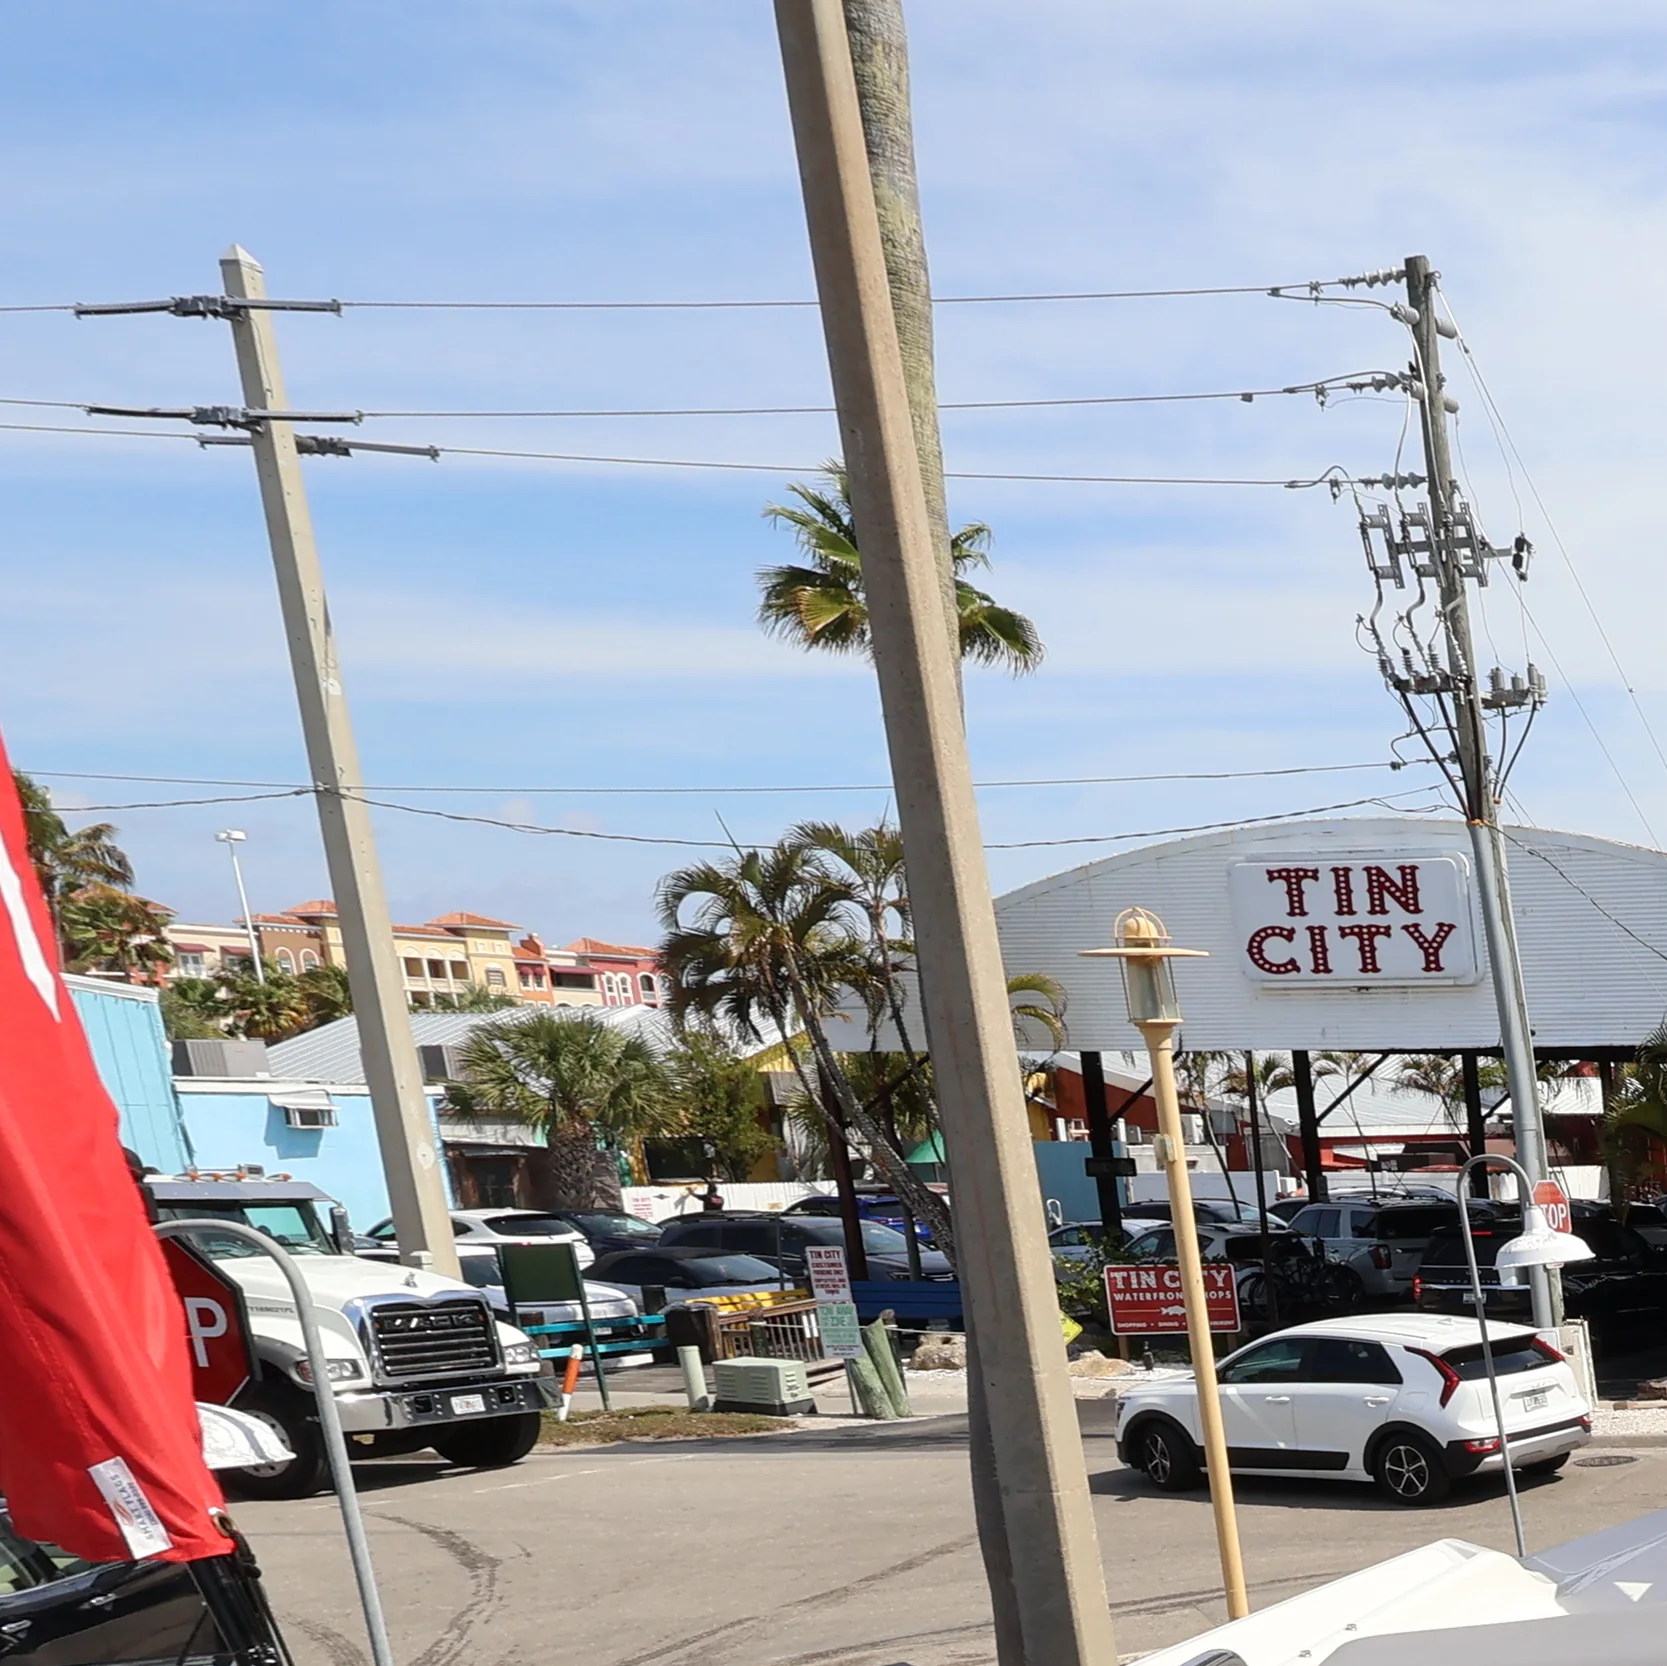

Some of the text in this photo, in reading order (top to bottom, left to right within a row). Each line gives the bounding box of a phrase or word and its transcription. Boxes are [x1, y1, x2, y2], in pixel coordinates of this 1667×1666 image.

[1266, 865, 1424, 917] TIN
[1246, 922, 1457, 975] CITY
[1540, 1203, 1567, 1229] TOP
[809, 1250, 841, 1260] TIN CITY
[1110, 1269, 1229, 1289] TIN CY
[1113, 1291, 1232, 1301] WATERFRON OPS
[384, 1314, 475, 1330] MACK
[110, 1474, 134, 1505] FLAGS
